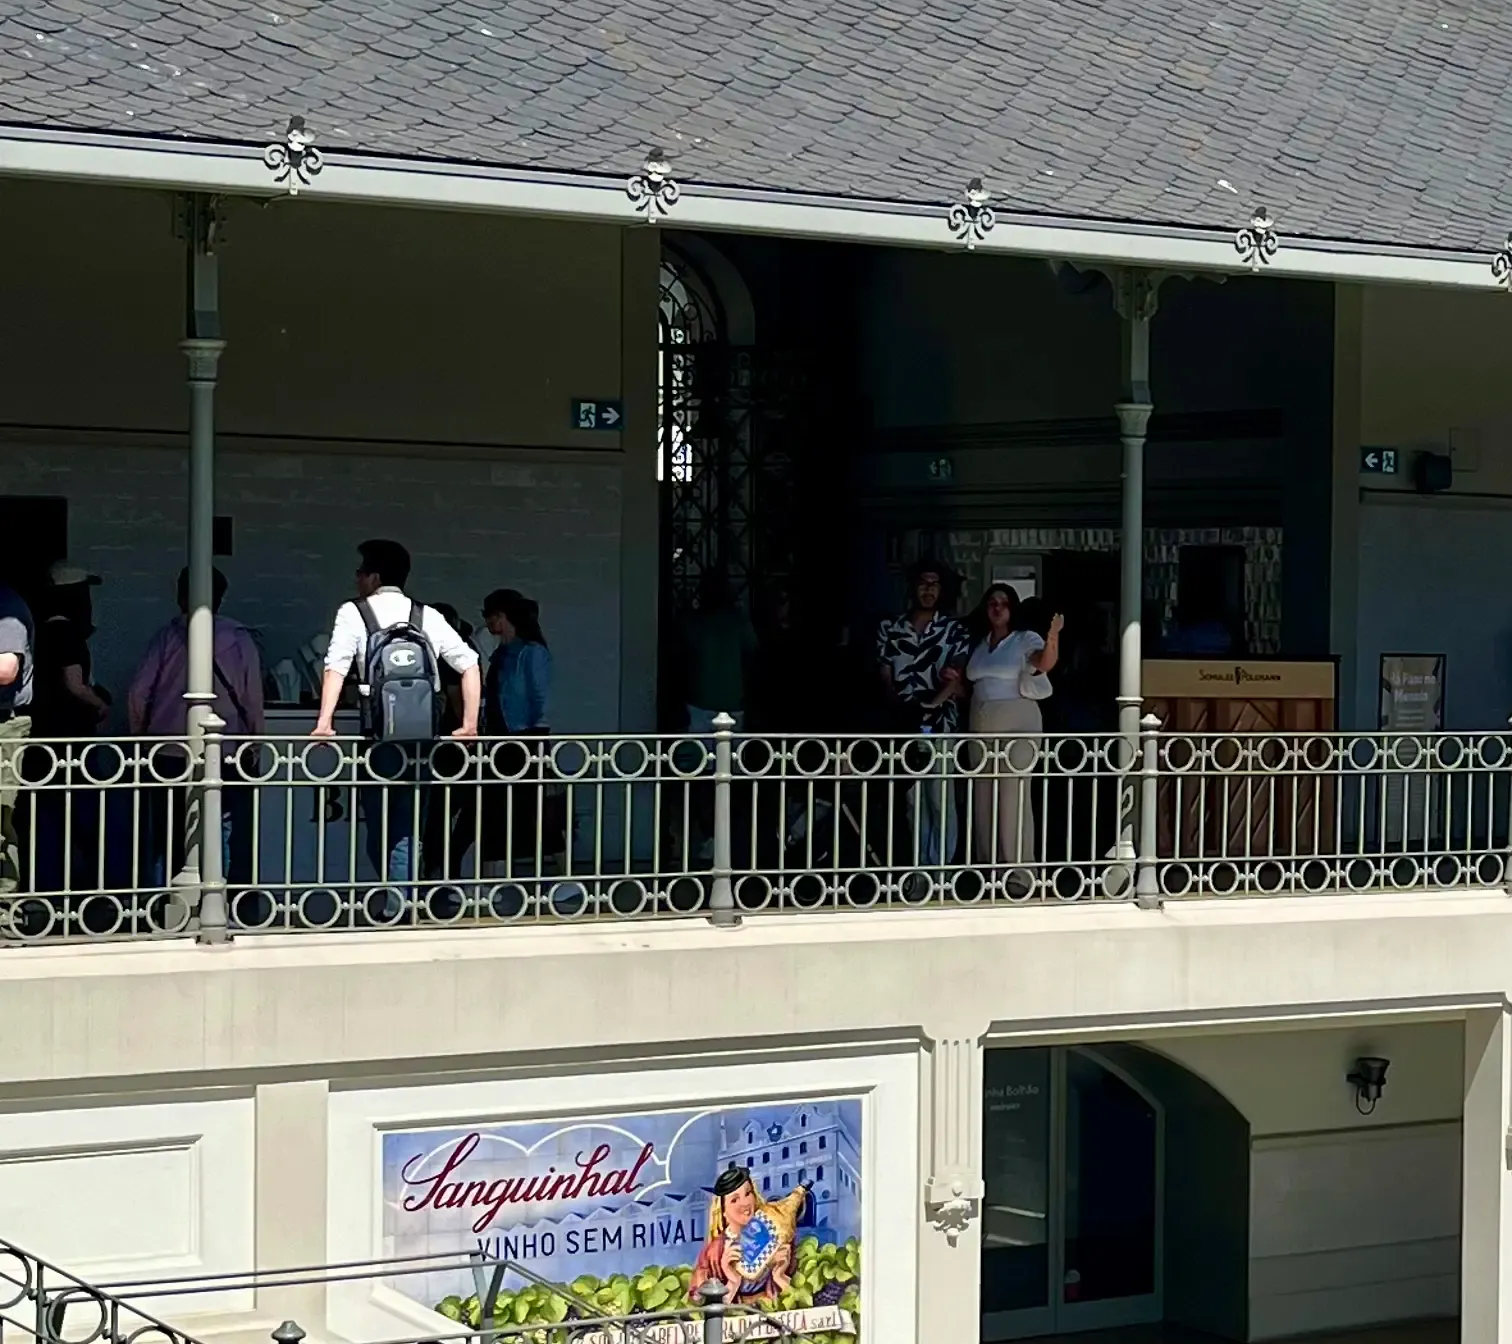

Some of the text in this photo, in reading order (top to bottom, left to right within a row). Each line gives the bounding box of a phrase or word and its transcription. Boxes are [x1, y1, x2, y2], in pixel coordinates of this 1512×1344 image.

[402, 1133, 654, 1233] Sanguinhal
[477, 1215, 706, 1262] VINHO SEM RIVAL
